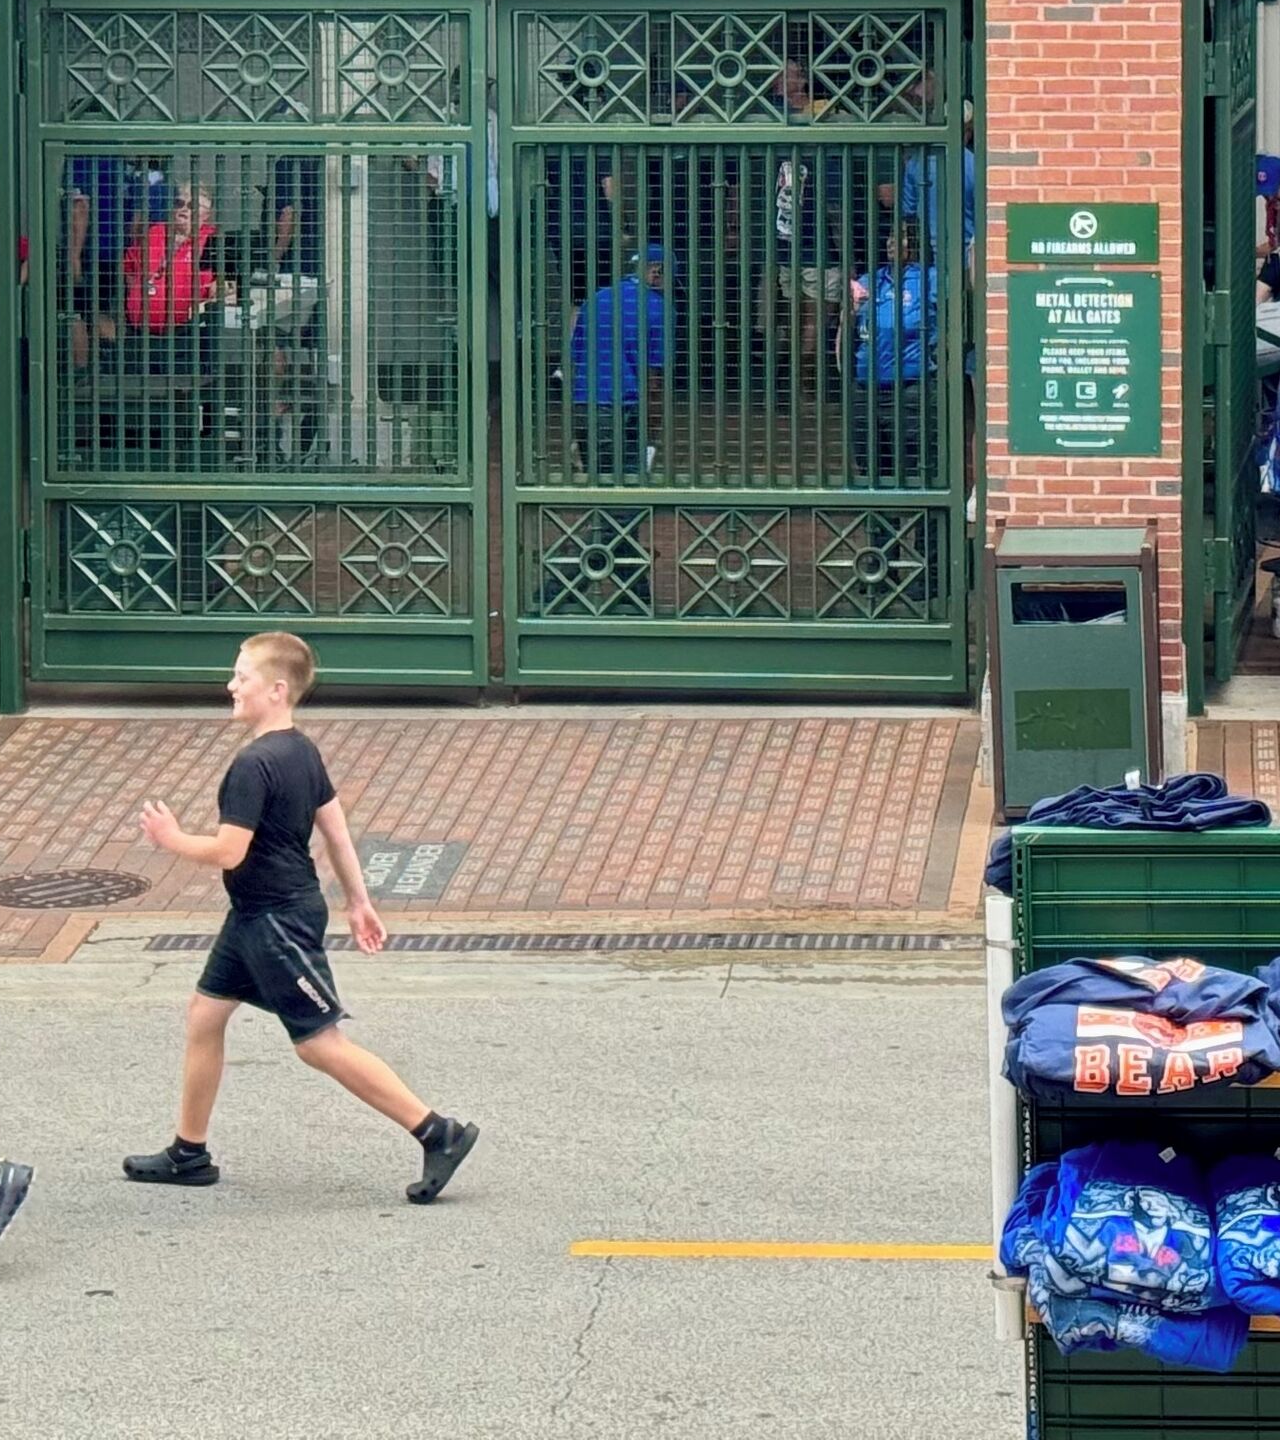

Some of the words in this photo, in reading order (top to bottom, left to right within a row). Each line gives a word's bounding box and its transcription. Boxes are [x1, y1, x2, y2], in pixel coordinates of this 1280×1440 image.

[1031, 241, 1045, 254] NO
[1046, 241, 1092, 255] FIREARMS
[1093, 242, 1136, 255] ALLOWED
[1036, 293, 1072, 308] METAL
[1073, 293, 1133, 308] DETECTION
[1048, 309, 1062, 324] AT
[1064, 309, 1084, 324] ALL
[1086, 309, 1121, 324] GATES
[391, 843, 446, 896] ALEXANDER
[1073, 1043, 1244, 1096] BEAR
